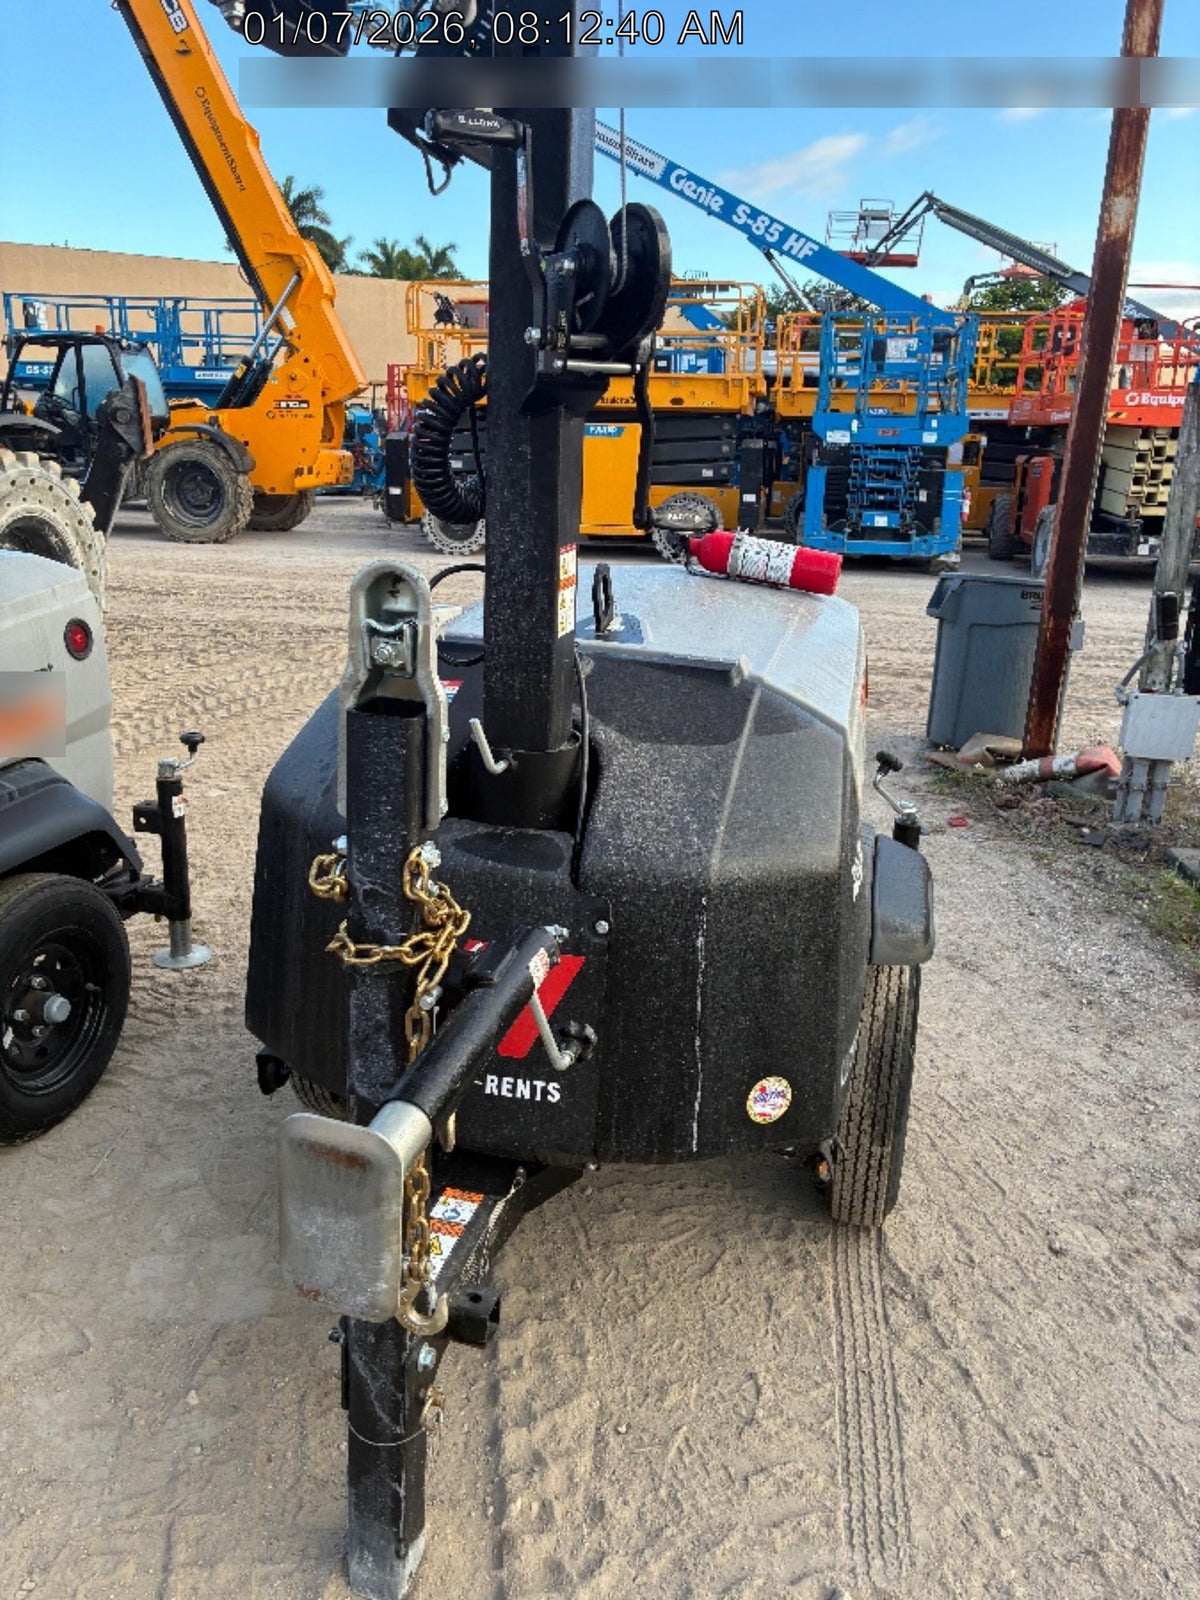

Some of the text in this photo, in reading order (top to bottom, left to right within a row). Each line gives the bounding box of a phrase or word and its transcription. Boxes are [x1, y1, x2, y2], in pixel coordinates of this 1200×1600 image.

[161, 0, 188, 33] CB
[669, 168, 820, 260] Genie S-85 HF
